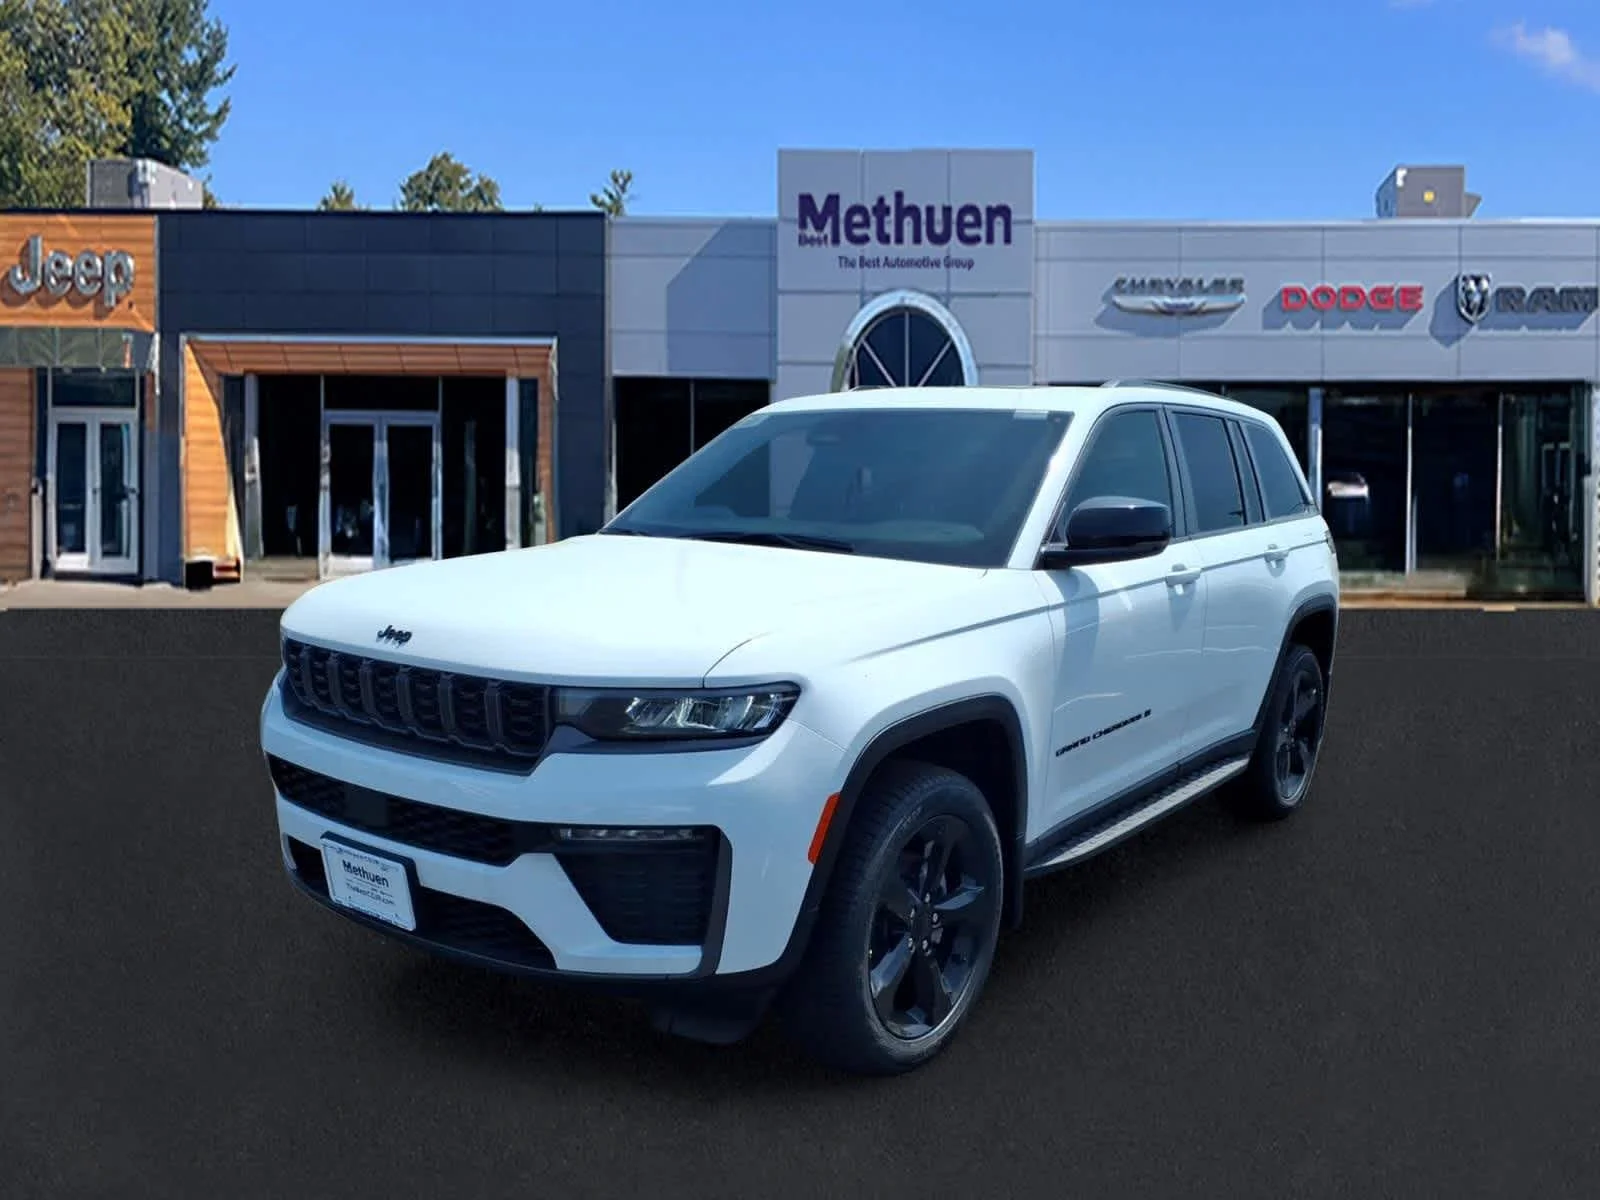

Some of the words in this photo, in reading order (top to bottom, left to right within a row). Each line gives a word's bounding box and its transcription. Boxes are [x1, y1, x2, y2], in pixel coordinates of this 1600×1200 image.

[798, 190, 1012, 246] Methuen
[798, 233, 829, 248] Best
[8, 234, 136, 308] Jeep
[838, 255, 857, 269] The
[859, 255, 880, 269] Best
[882, 255, 941, 269] Automotive
[943, 255, 975, 271] Group
[1113, 277, 1246, 296] CHRYSLER
[1281, 285, 1424, 311] DODGE
[1495, 286, 1599, 313] RAM
[377, 624, 412, 647] Jeep
[342, 859, 390, 889] Methuen
